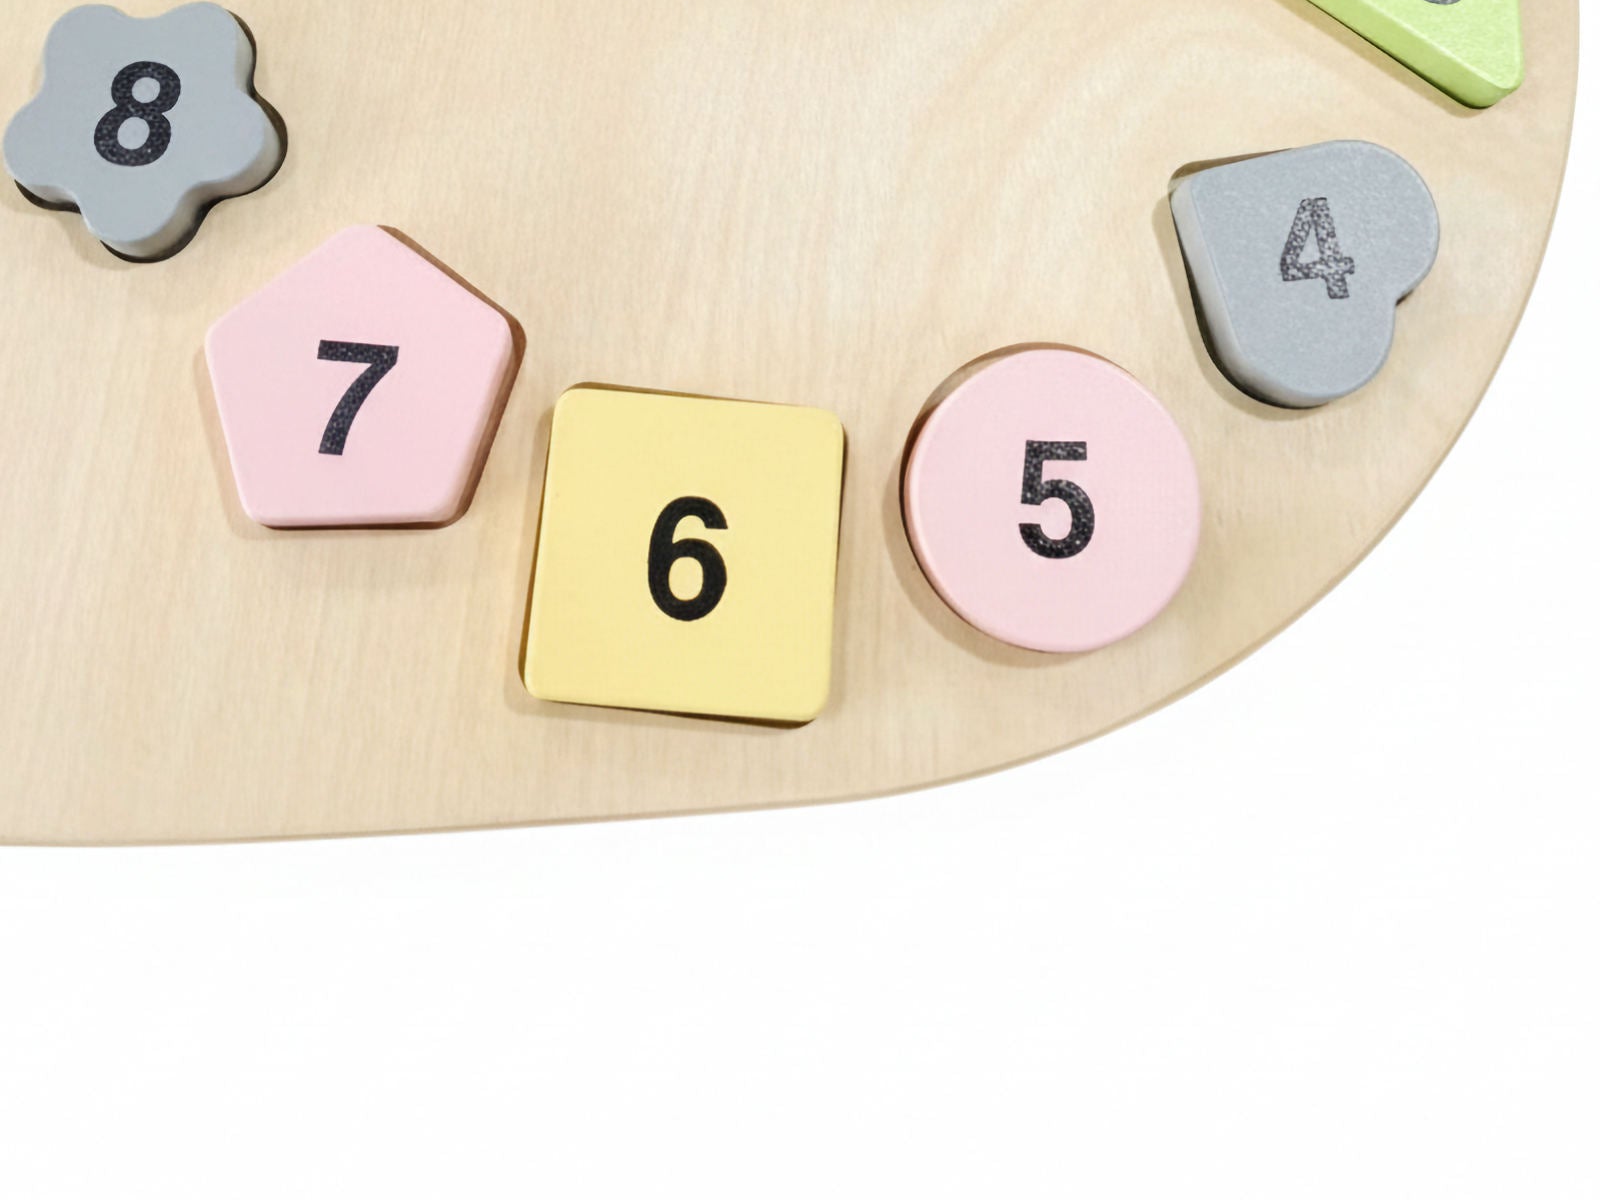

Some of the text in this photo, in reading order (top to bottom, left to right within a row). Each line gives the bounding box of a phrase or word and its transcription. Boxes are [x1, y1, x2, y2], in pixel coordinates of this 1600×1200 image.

[93, 60, 182, 167] 8
[1279, 196, 1355, 300] 4
[317, 339, 399, 456] 7
[1018, 439, 1096, 559] 5
[647, 495, 728, 622] 6
